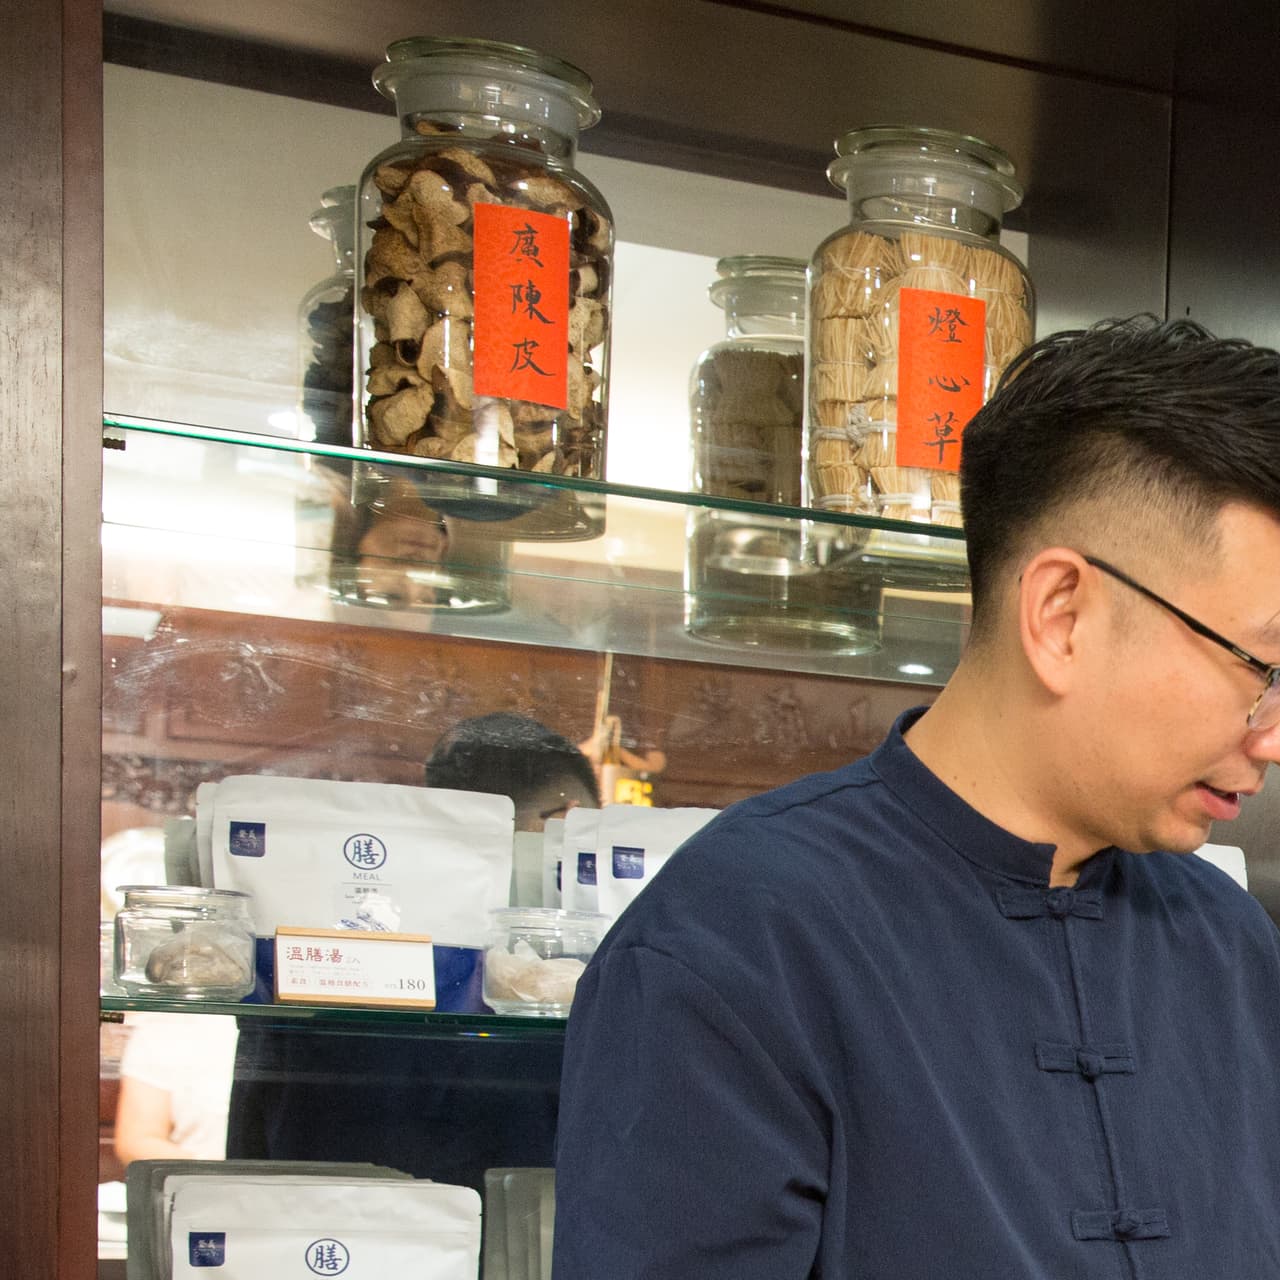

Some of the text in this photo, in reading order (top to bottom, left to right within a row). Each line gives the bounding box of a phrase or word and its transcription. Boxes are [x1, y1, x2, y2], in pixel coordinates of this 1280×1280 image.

[508, 223, 557, 377] 廣陳皮
[351, 838, 380, 866] 膳
[352, 871, 382, 881] MEAL
[286, 945, 344, 964] 溫膳湯
[313, 1243, 343, 1271] 膳
